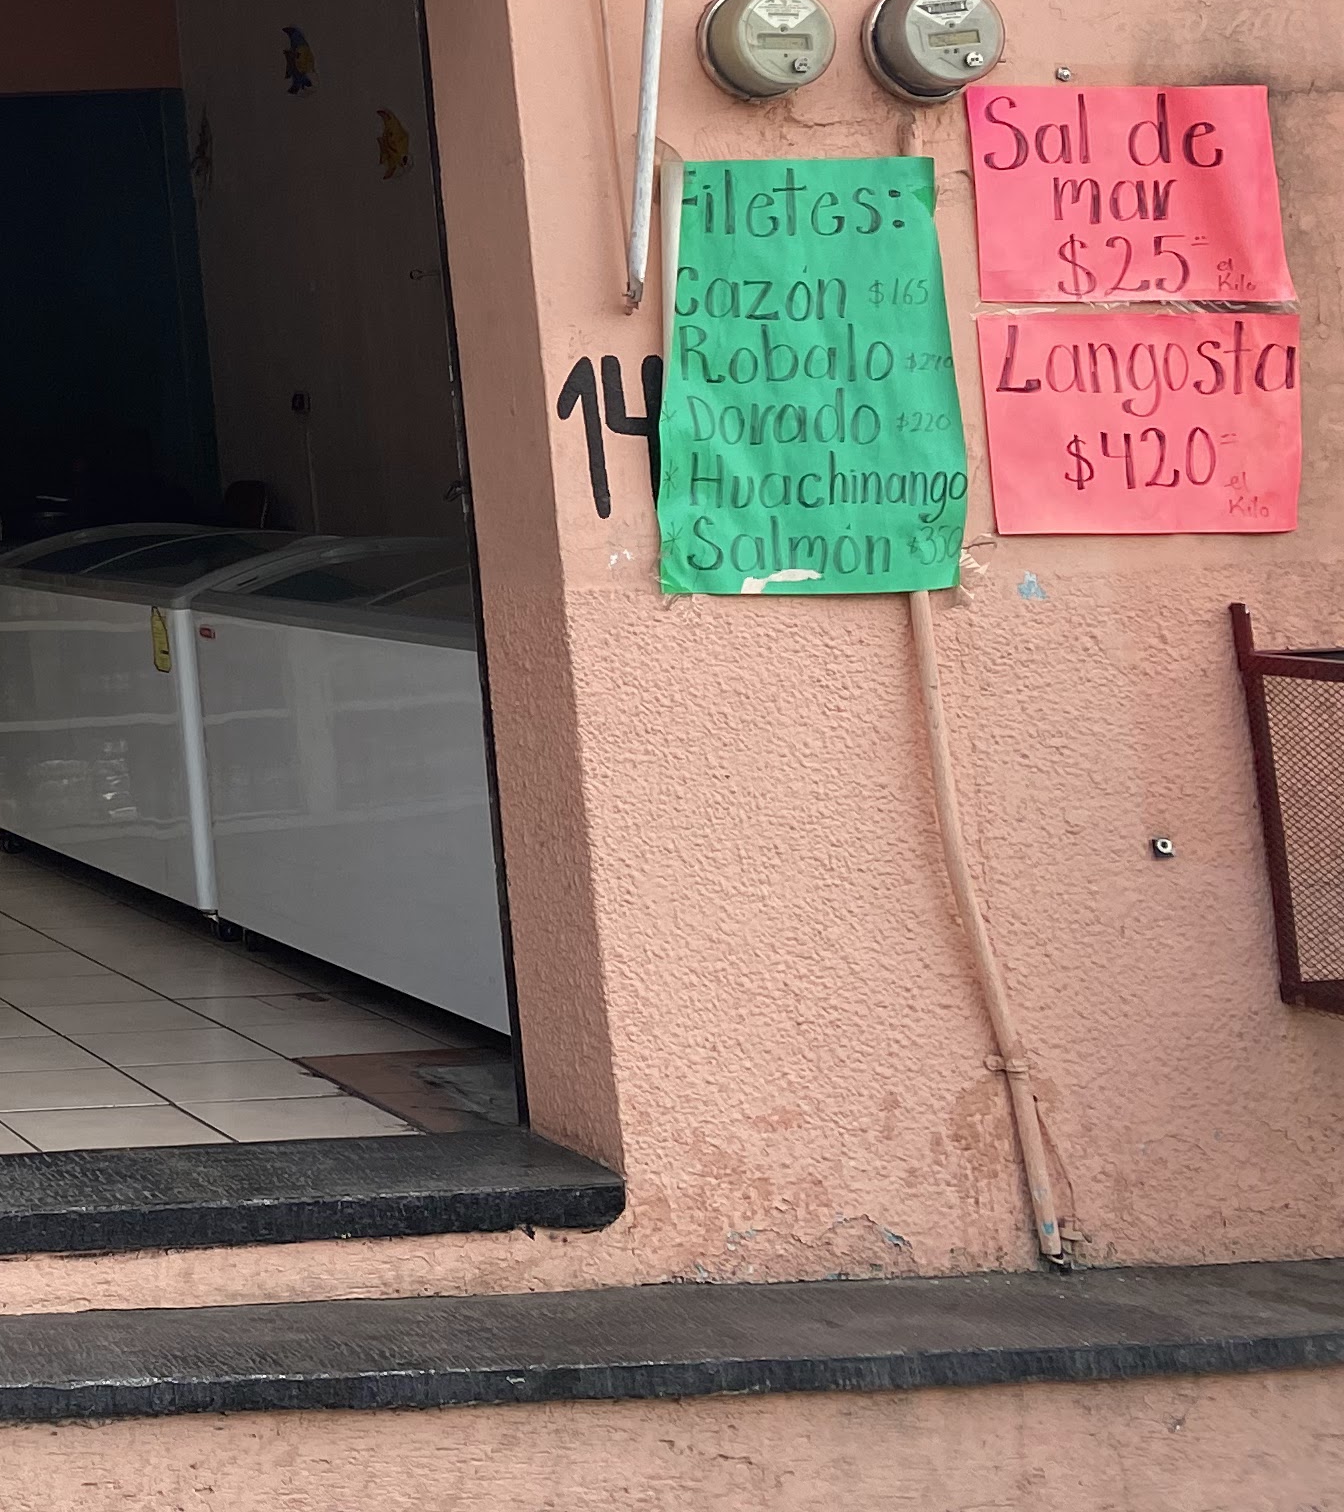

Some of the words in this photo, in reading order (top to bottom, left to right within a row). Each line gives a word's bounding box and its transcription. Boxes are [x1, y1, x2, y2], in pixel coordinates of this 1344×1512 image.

[983, 93, 1090, 170] Sal
[1128, 93, 1223, 168] de
[1054, 177, 1178, 224] mar
[1216, 257, 1233, 271] el
[1218, 272, 1257, 292] Kilo
[868, 277, 929, 308] $165
[679, 324, 894, 384] Robalo
[996, 321, 1296, 417] Langosta
[687, 388, 882, 445] Dorado
[896, 411, 952, 432] $220
[689, 451, 968, 524] Huachinango
[1223, 471, 1250, 492] el
[907, 525, 963, 566] $350
